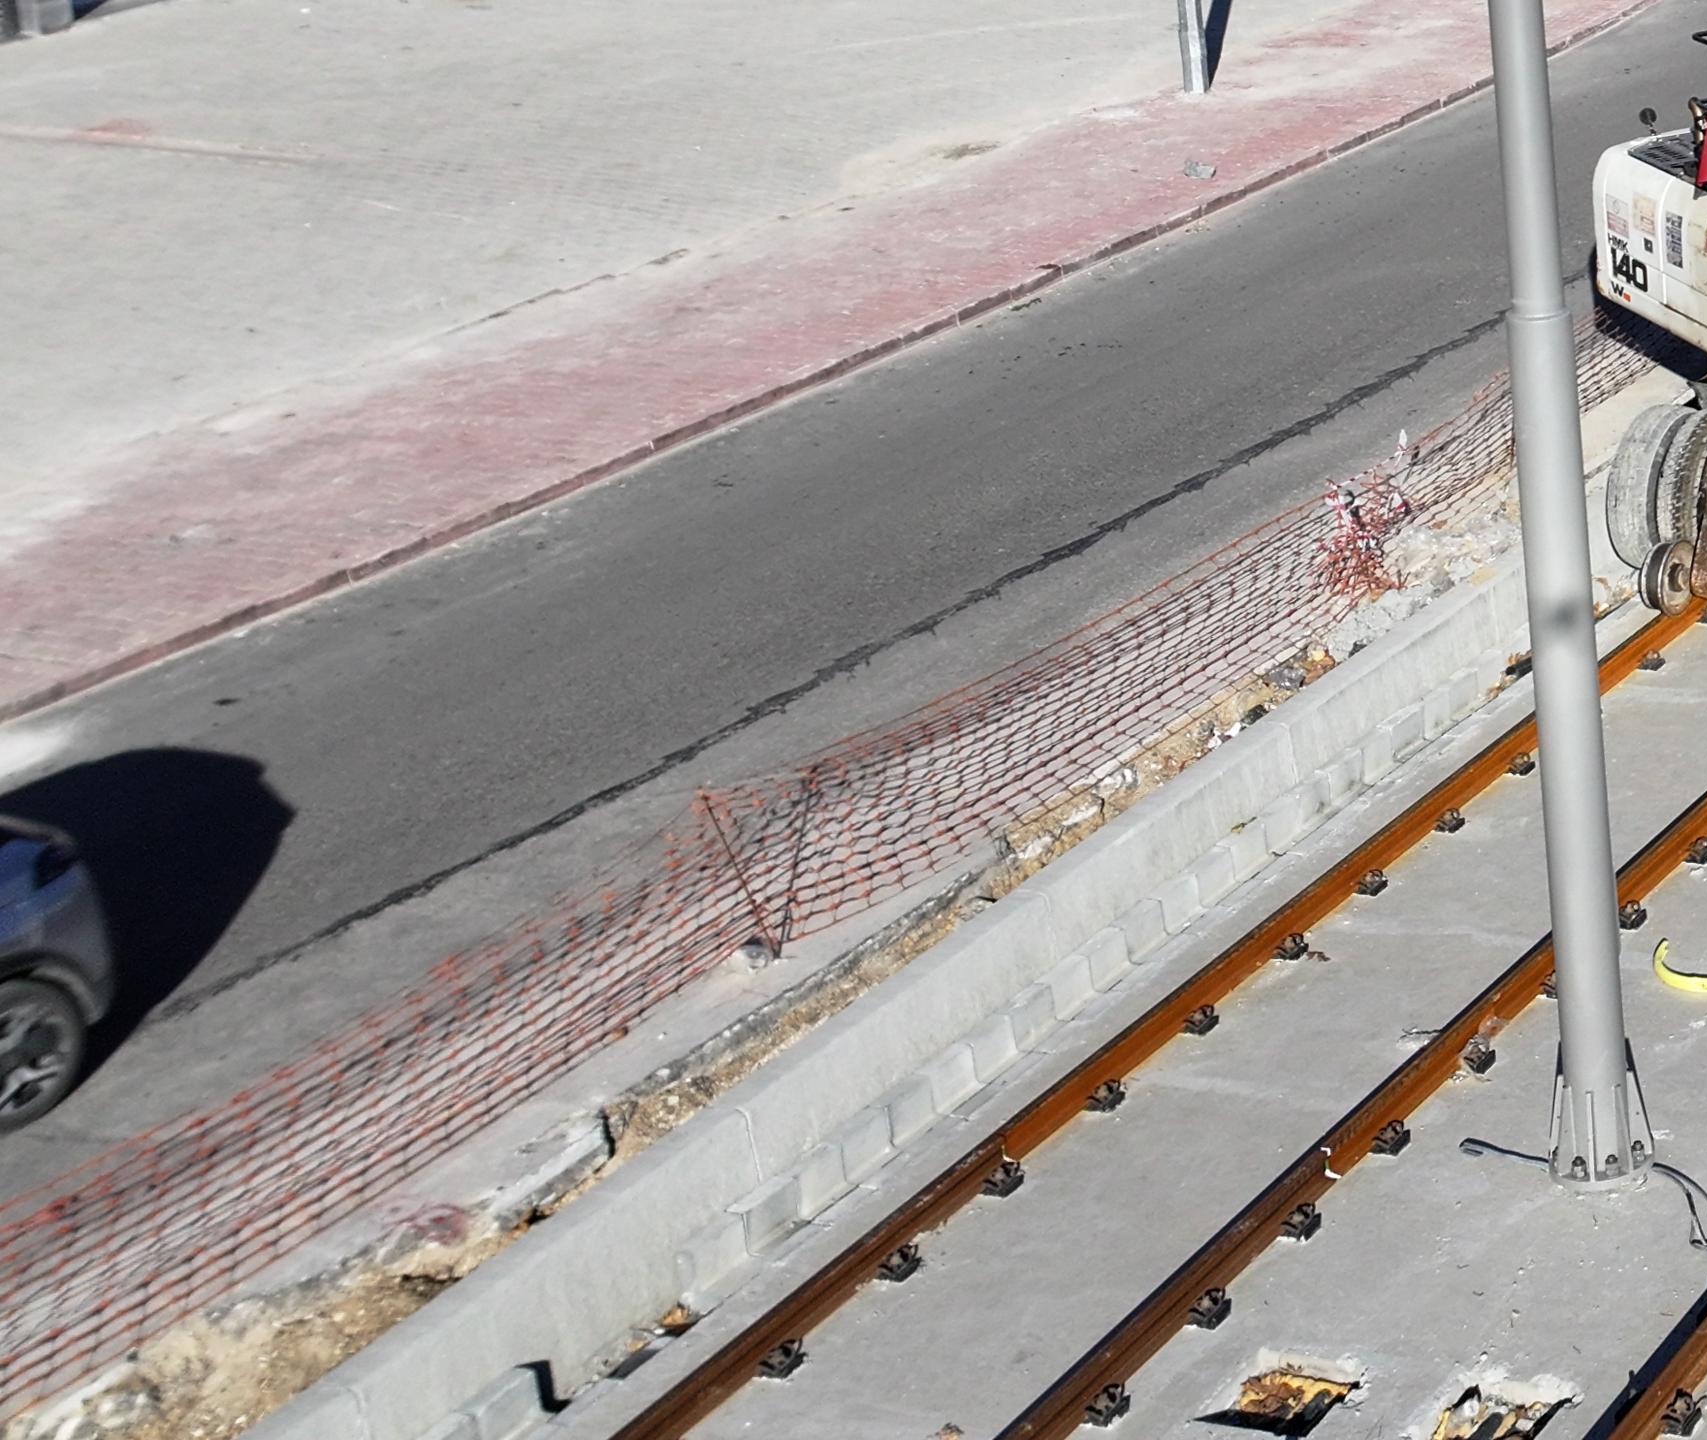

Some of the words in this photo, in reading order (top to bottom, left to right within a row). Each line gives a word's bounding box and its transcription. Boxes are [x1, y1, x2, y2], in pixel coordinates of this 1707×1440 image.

[1607, 232, 1629, 254] HMK
[1610, 246, 1649, 293] 140
[1611, 280, 1625, 297] W
